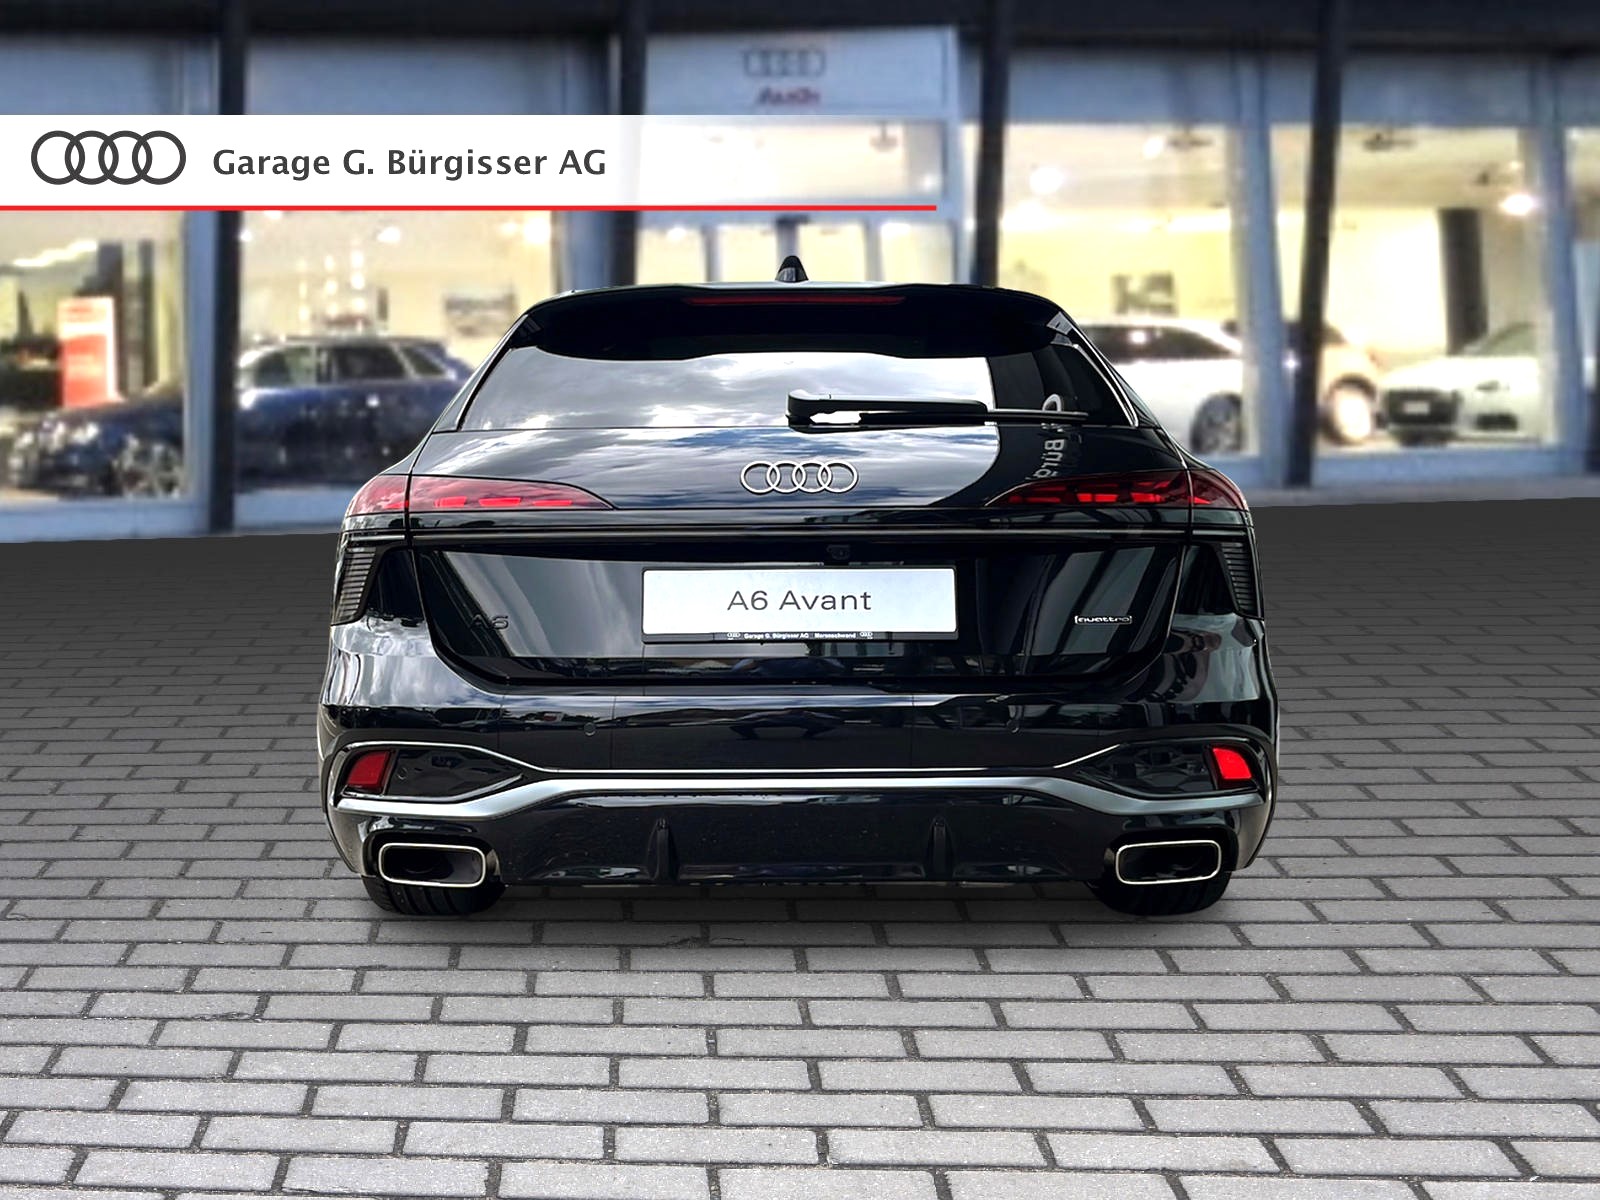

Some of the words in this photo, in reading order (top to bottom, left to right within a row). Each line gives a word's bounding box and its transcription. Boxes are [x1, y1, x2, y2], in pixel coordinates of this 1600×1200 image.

[727, 590, 769, 611] A6
[779, 590, 872, 611] Avant
[1075, 615, 1132, 624] quattro
[743, 632, 764, 640] Garage
